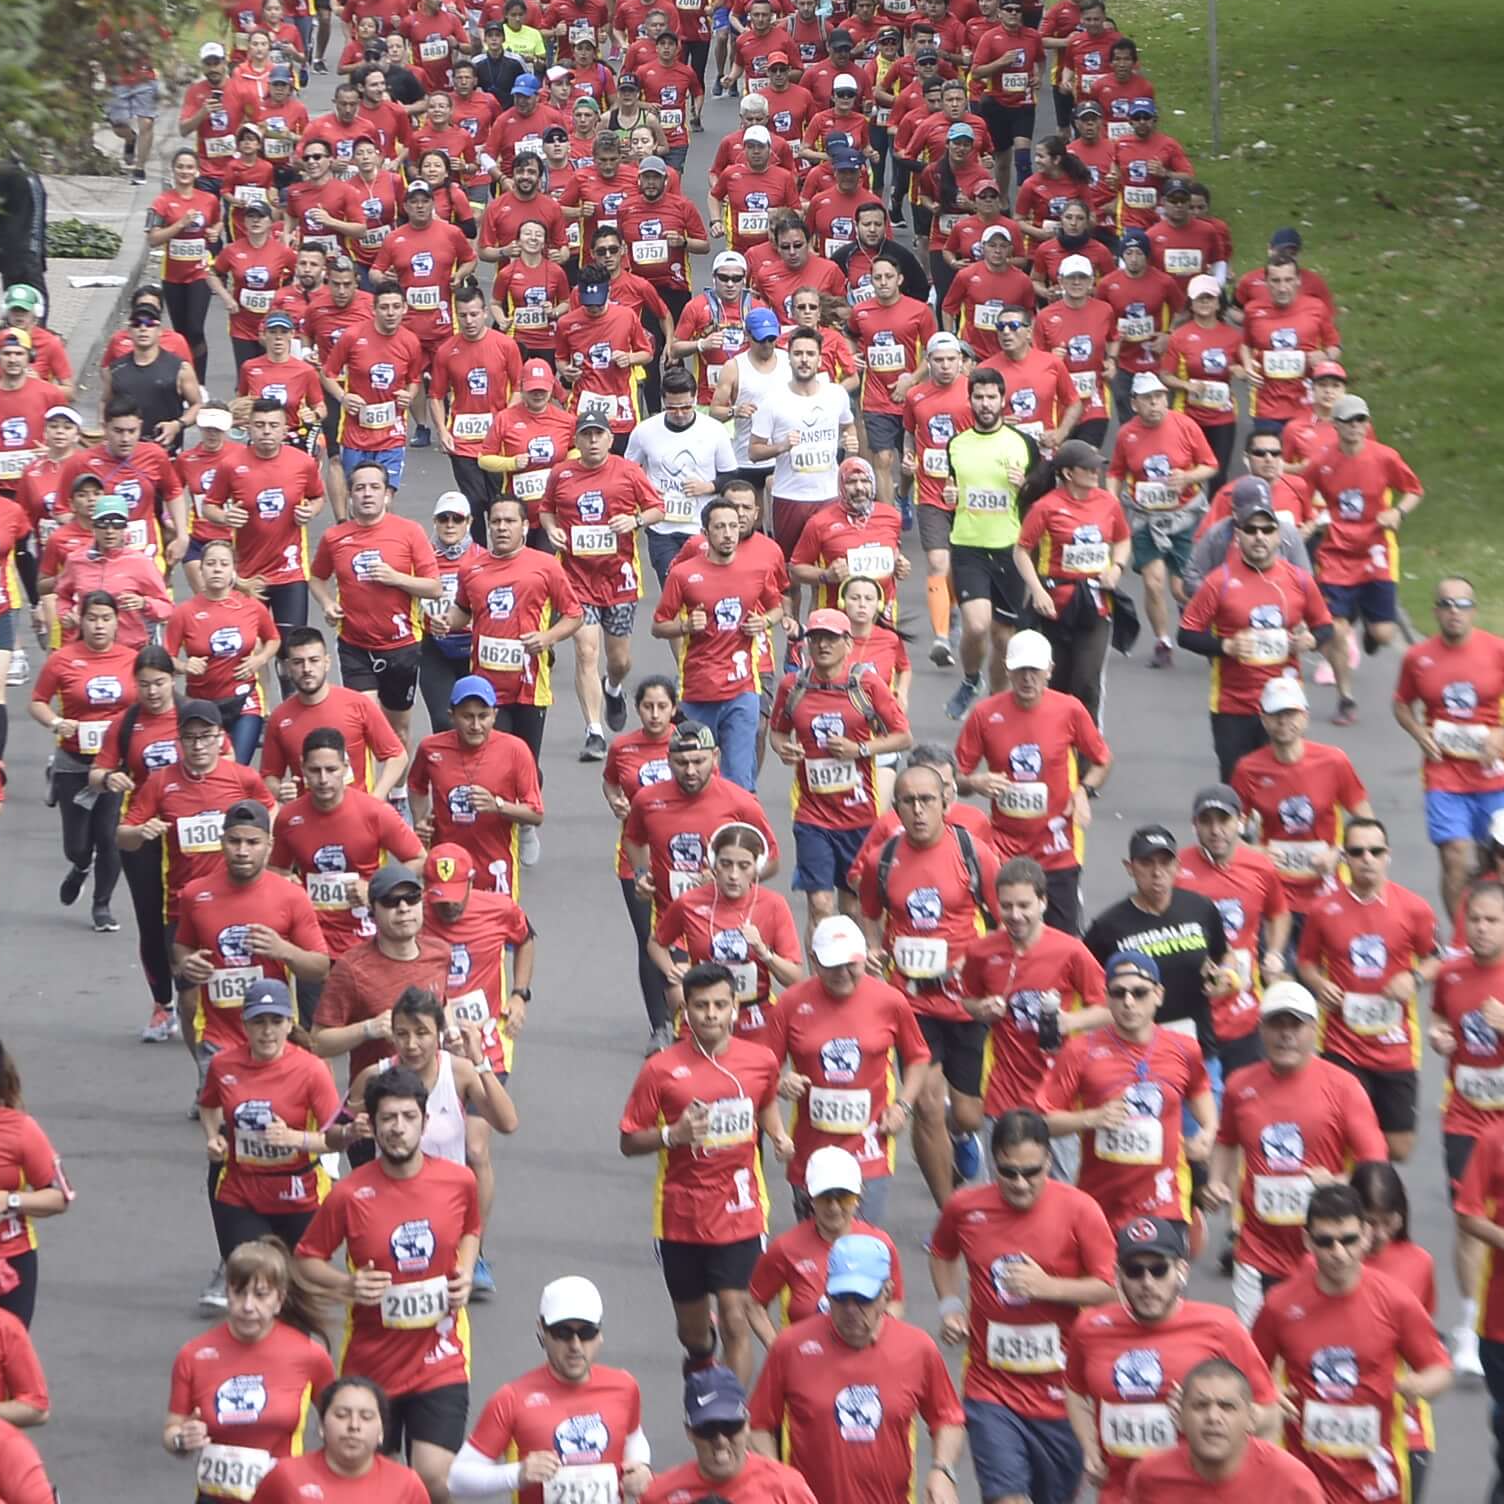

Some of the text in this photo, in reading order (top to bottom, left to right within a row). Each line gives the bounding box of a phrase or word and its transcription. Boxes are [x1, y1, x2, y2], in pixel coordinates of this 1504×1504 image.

[636, 245, 665, 261] 3757
[410, 291, 440, 305] 1401
[515, 311, 546, 325] 2381
[869, 353, 903, 367] 2834
[365, 409, 390, 426] 361
[455, 420, 490, 436] 4924
[796, 453, 831, 469] 4015
[664, 499, 692, 517] 016
[968, 490, 1008, 509] 2394
[575, 531, 615, 550] 4375
[480, 643, 522, 665] 4626
[809, 765, 853, 787] 3927
[900, 949, 937, 969] 1177
[811, 1098, 867, 1124] 3363
[385, 1288, 446, 1319] 2031
